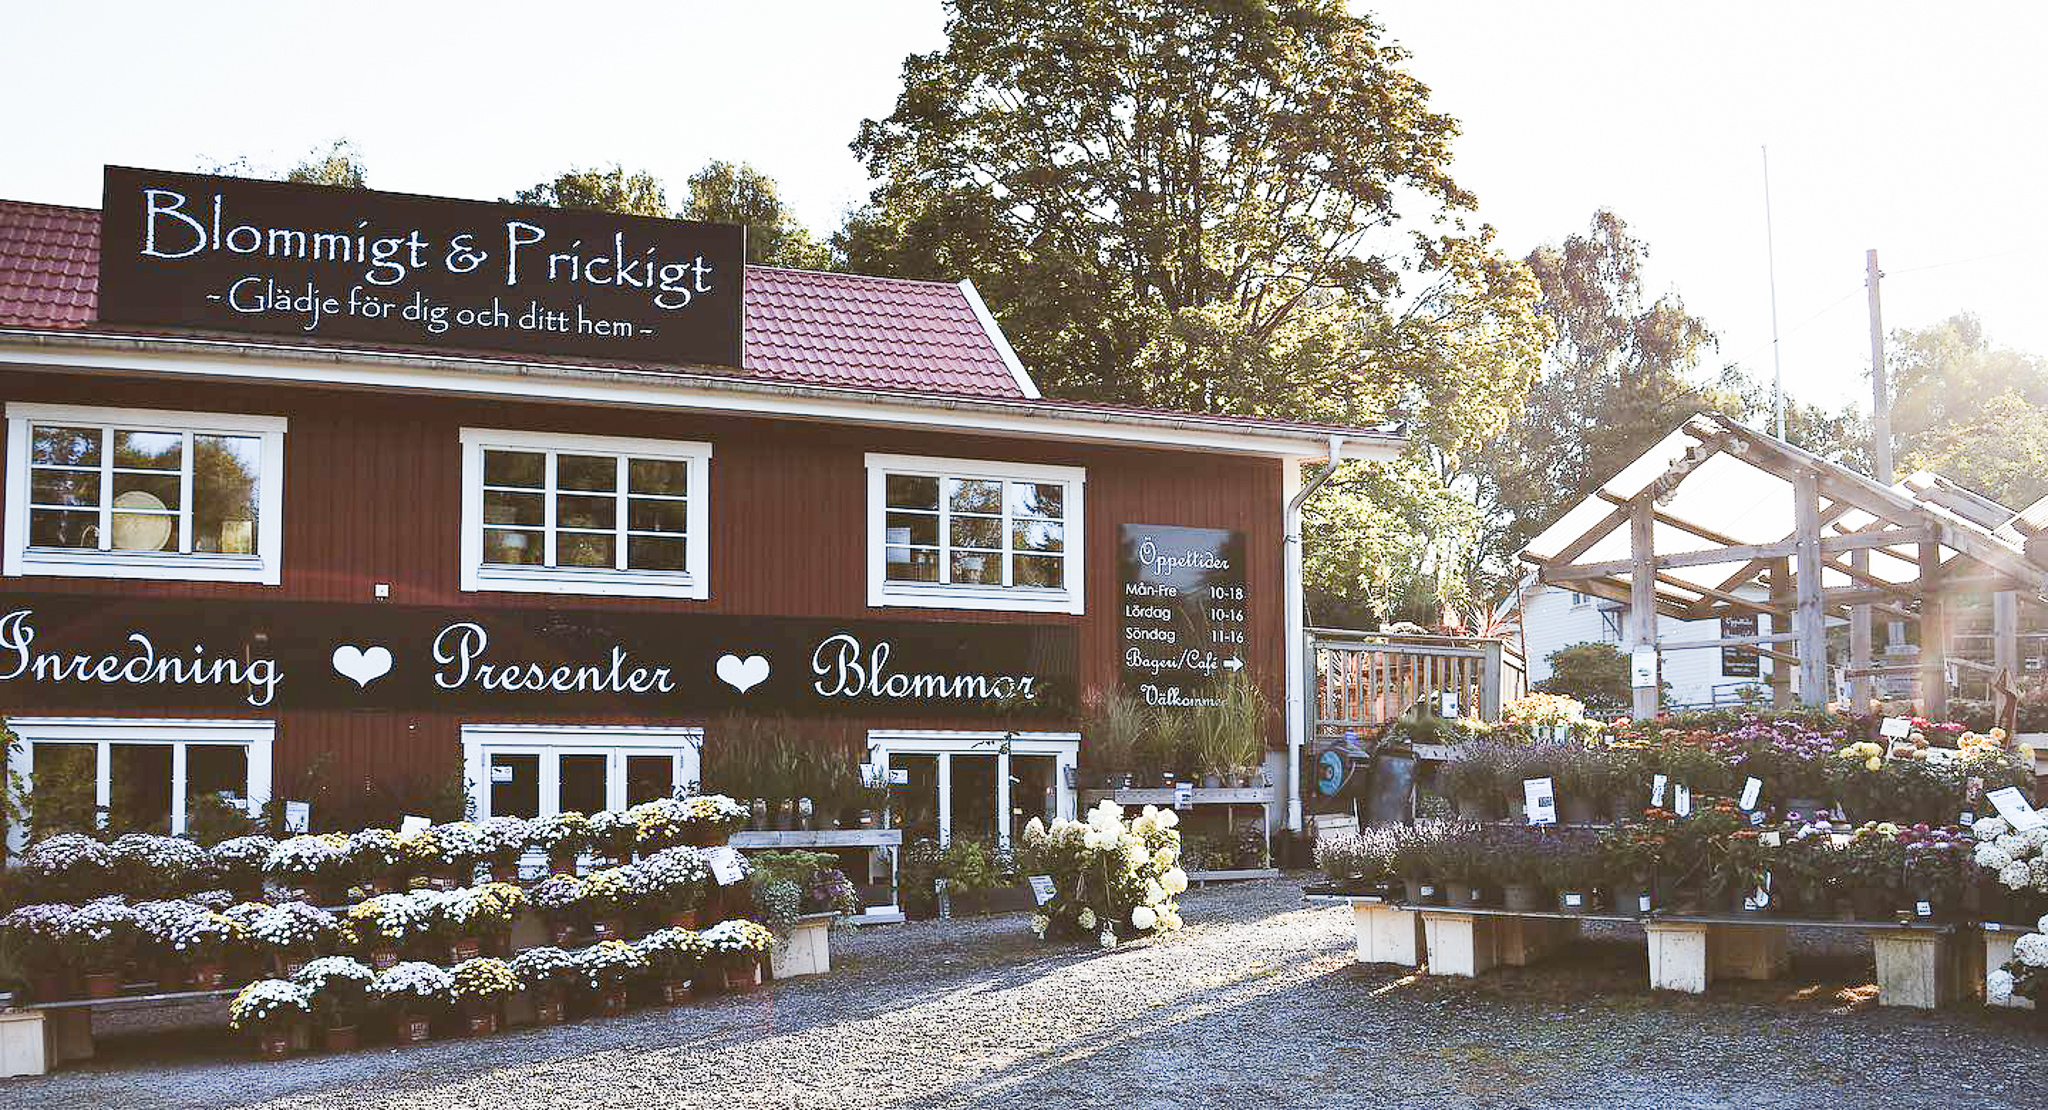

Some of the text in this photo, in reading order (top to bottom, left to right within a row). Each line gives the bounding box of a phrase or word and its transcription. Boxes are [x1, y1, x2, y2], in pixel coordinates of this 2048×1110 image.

[140, 189, 713, 310] Blommigt & Prickigt
[229, 277, 340, 331] Glädje
[347, 285, 396, 318] för
[402, 291, 449, 334] dig
[456, 296, 510, 328] och
[518, 300, 570, 333] ditt
[577, 304, 632, 337] hem
[1139, 536, 1230, 576] Öppettider
[1125, 582, 1244, 600] Mån-Fre 10-18
[1125, 604, 1244, 622] Lördag 10-16
[0, 610, 284, 707] Inredning
[433, 622, 676, 693] Presenter
[1125, 627, 1244, 644] Söndag 11-16
[811, 634, 1035, 700] Blommor
[1140, 684, 1228, 707] Välkomm
